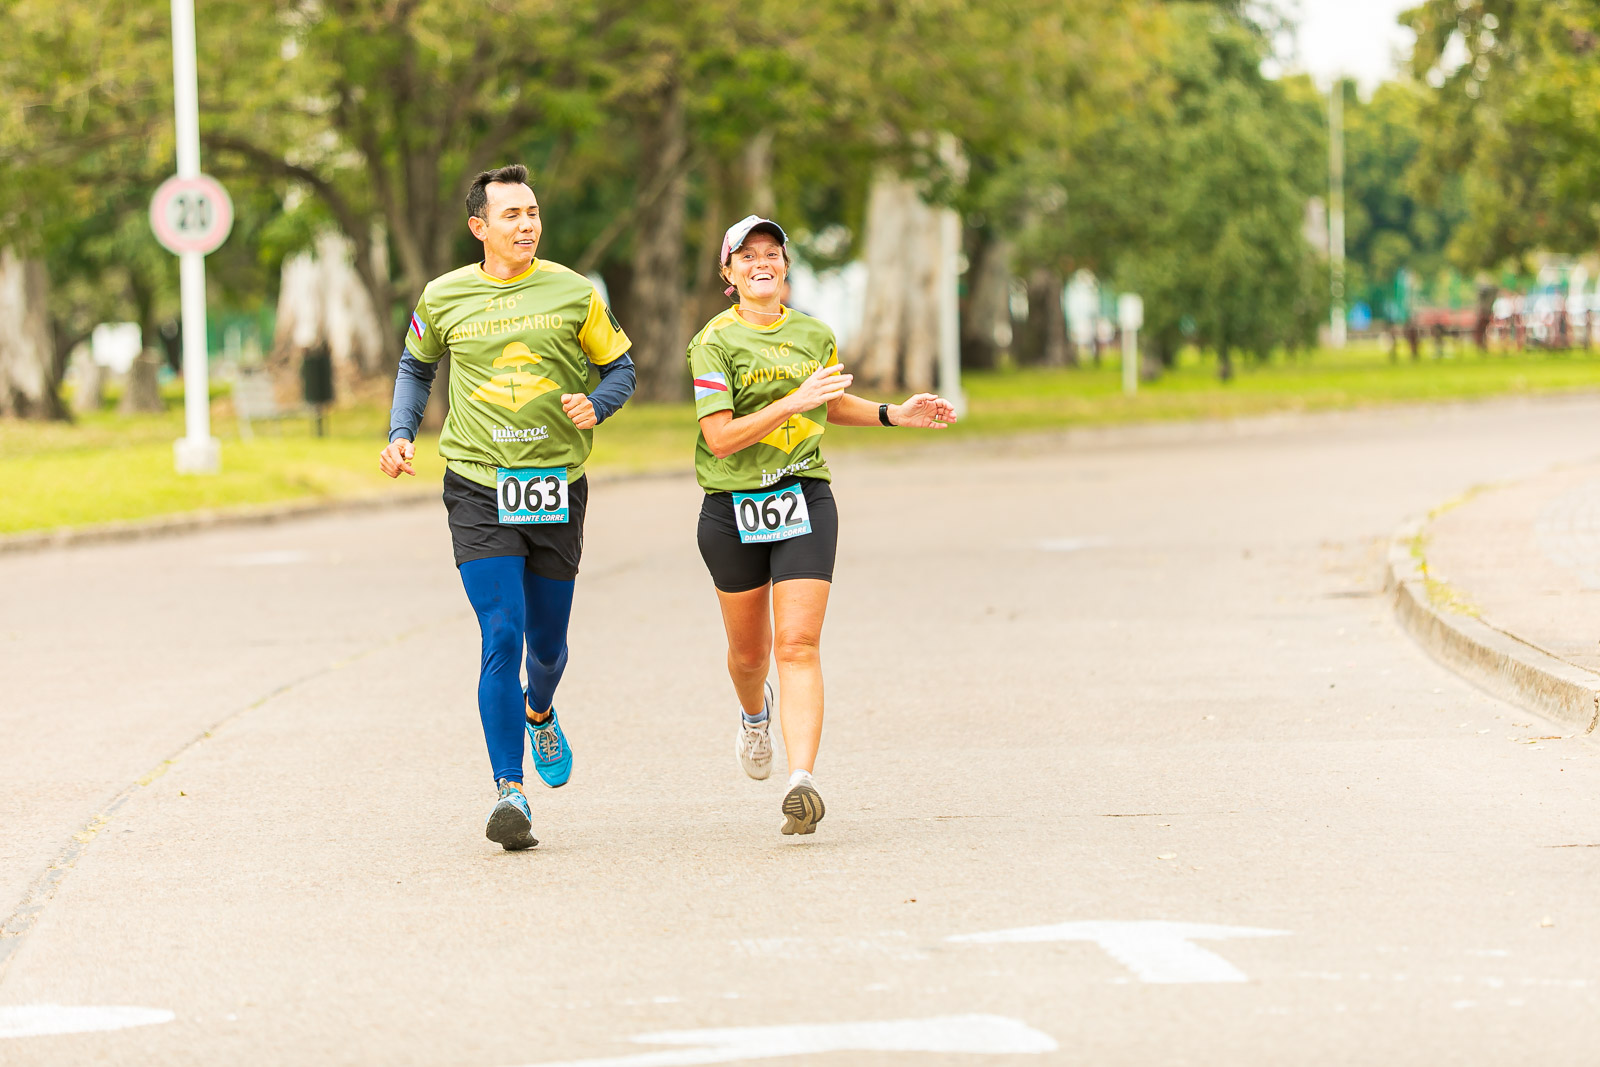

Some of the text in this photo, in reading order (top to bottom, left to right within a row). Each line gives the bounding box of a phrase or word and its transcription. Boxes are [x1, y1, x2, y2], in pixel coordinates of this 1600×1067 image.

[452, 314, 563, 342] ANIVERSARIO
[741, 359, 822, 387] ANIVERSAR
[502, 475, 562, 513] 063
[502, 513, 566, 522] DIAMANTE CORRE
[739, 490, 803, 533] 062
[744, 526, 807, 542] DIAMANTE CORRE
